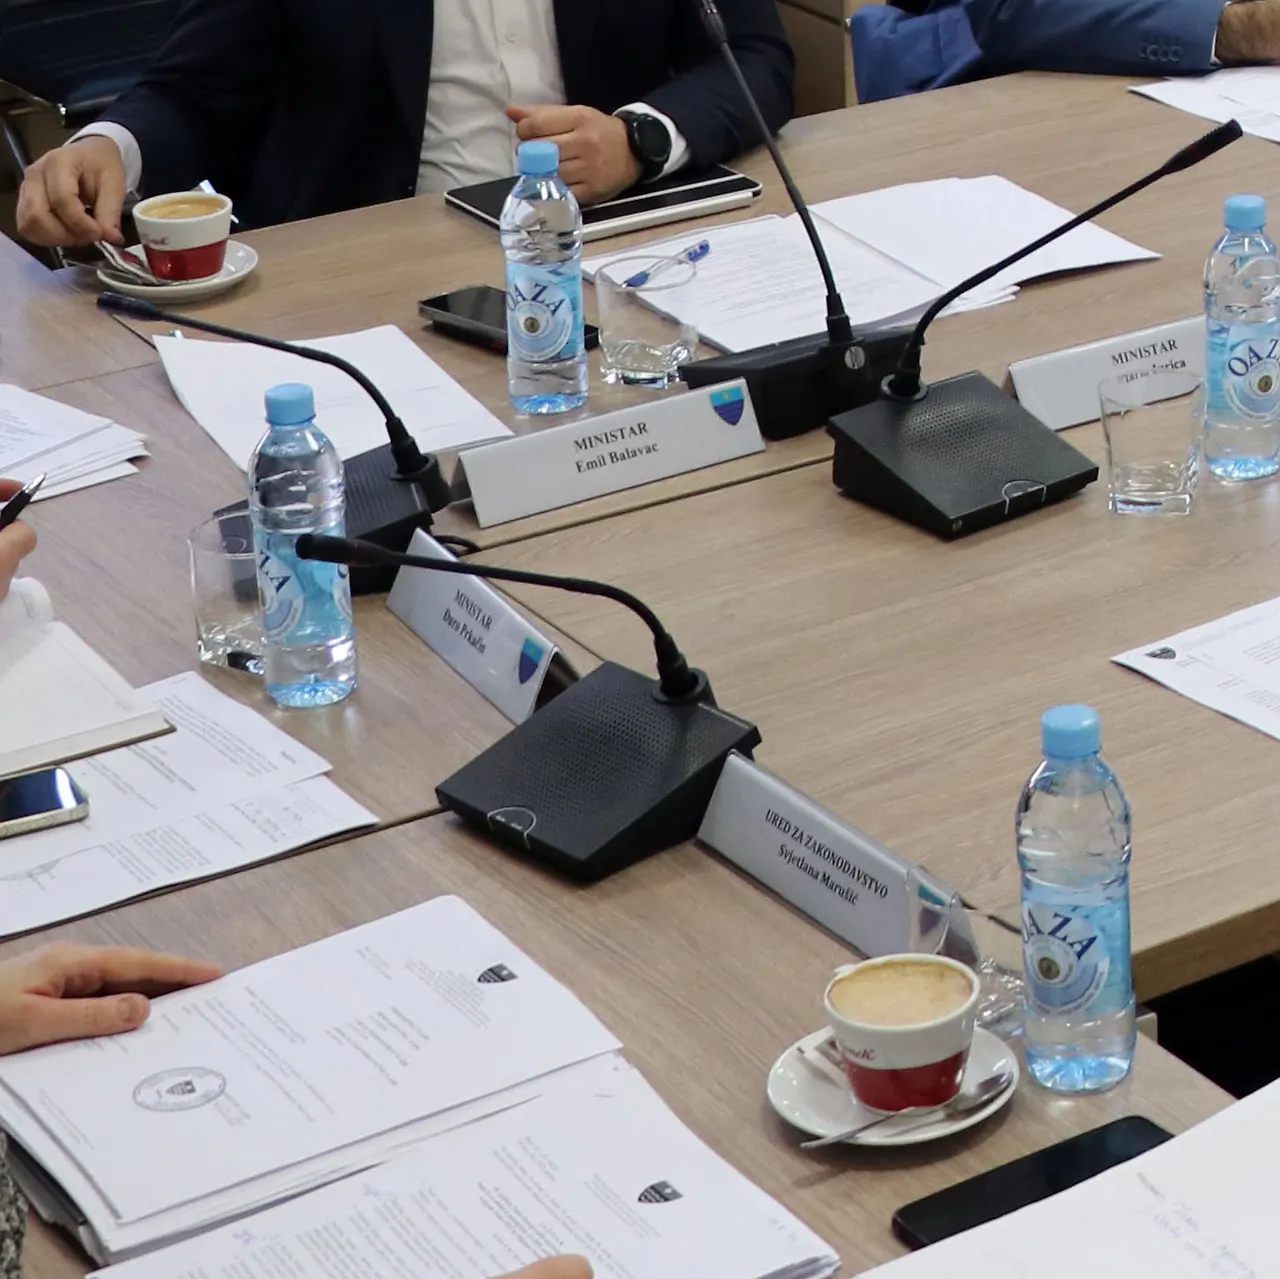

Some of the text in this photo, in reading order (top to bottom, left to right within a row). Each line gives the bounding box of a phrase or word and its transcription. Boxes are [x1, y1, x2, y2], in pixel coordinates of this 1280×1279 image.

[1111, 339, 1178, 367] MINISTAR
[574, 422, 649, 452] MINISTAR
[575, 442, 659, 473] Emil Balavac
[454, 589, 493, 632] MINISTAR
[765, 808, 889, 899] URED ZA ZAKONODAVSTVO
[779, 843, 819, 880] Svjetlana
